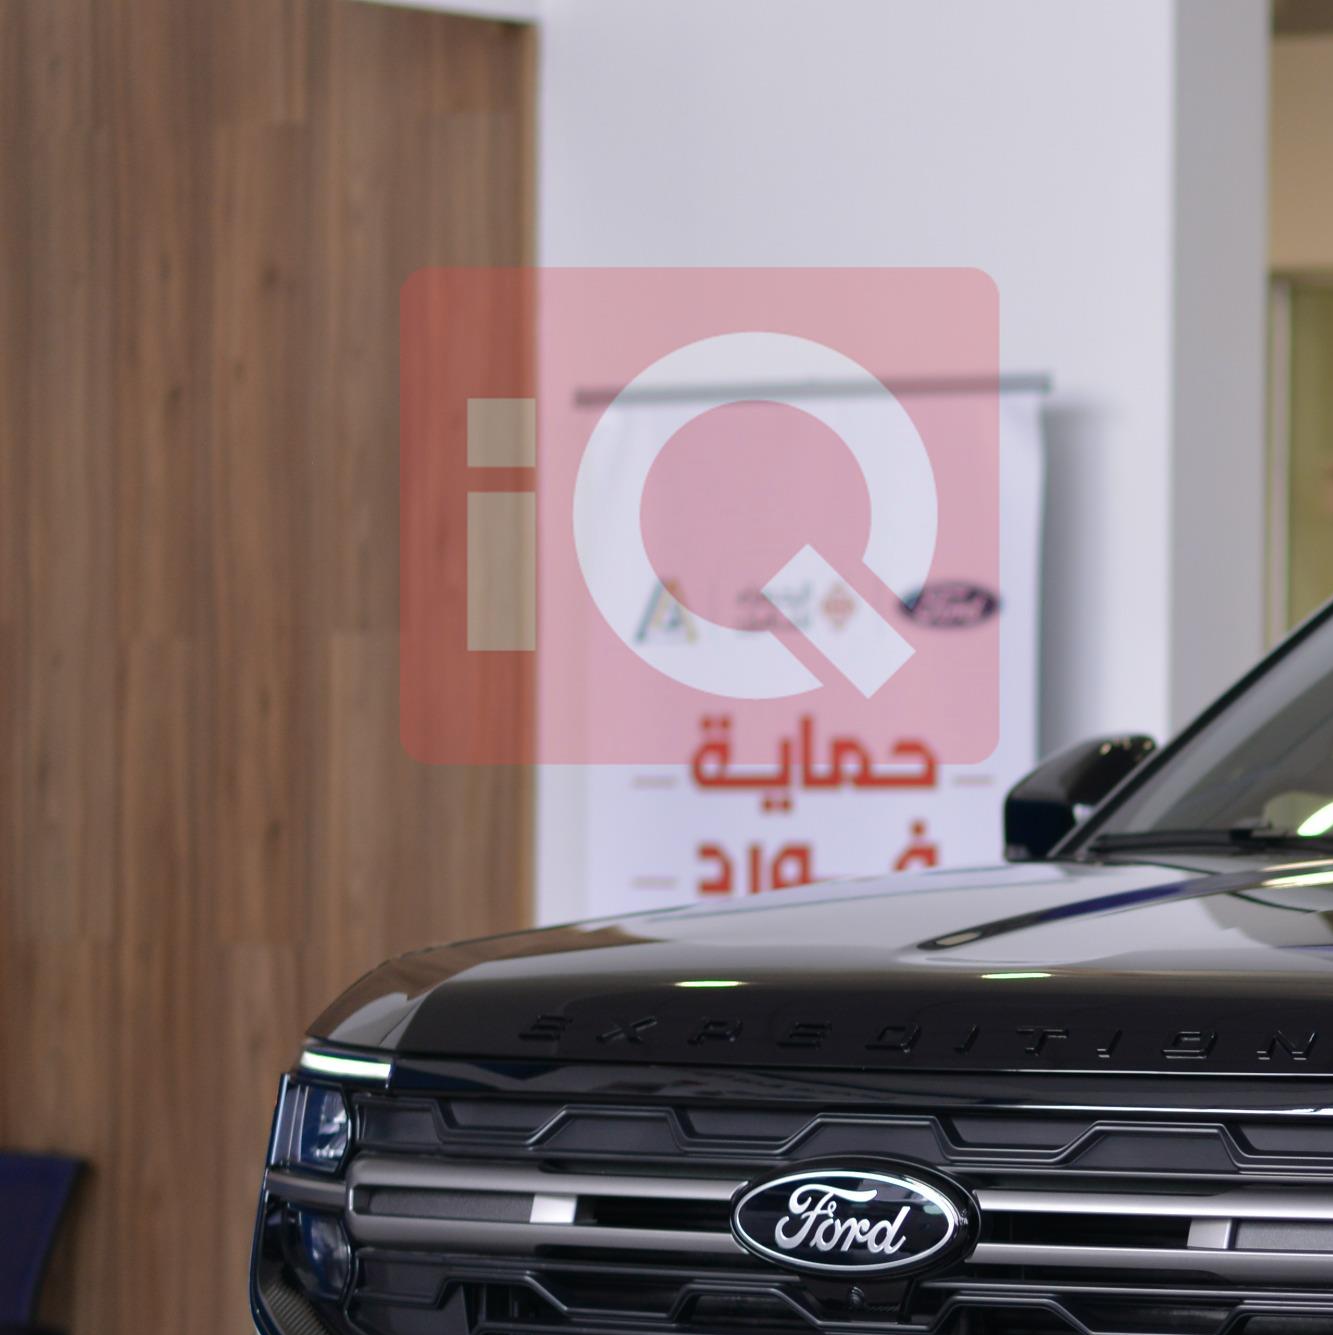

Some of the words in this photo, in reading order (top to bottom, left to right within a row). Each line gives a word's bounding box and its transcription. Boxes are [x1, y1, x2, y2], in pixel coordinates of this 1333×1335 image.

[690, 714, 938, 813] حماية
[518, 1014, 1318, 1061] EXPEDITION
[774, 1183, 911, 1255] Ford
